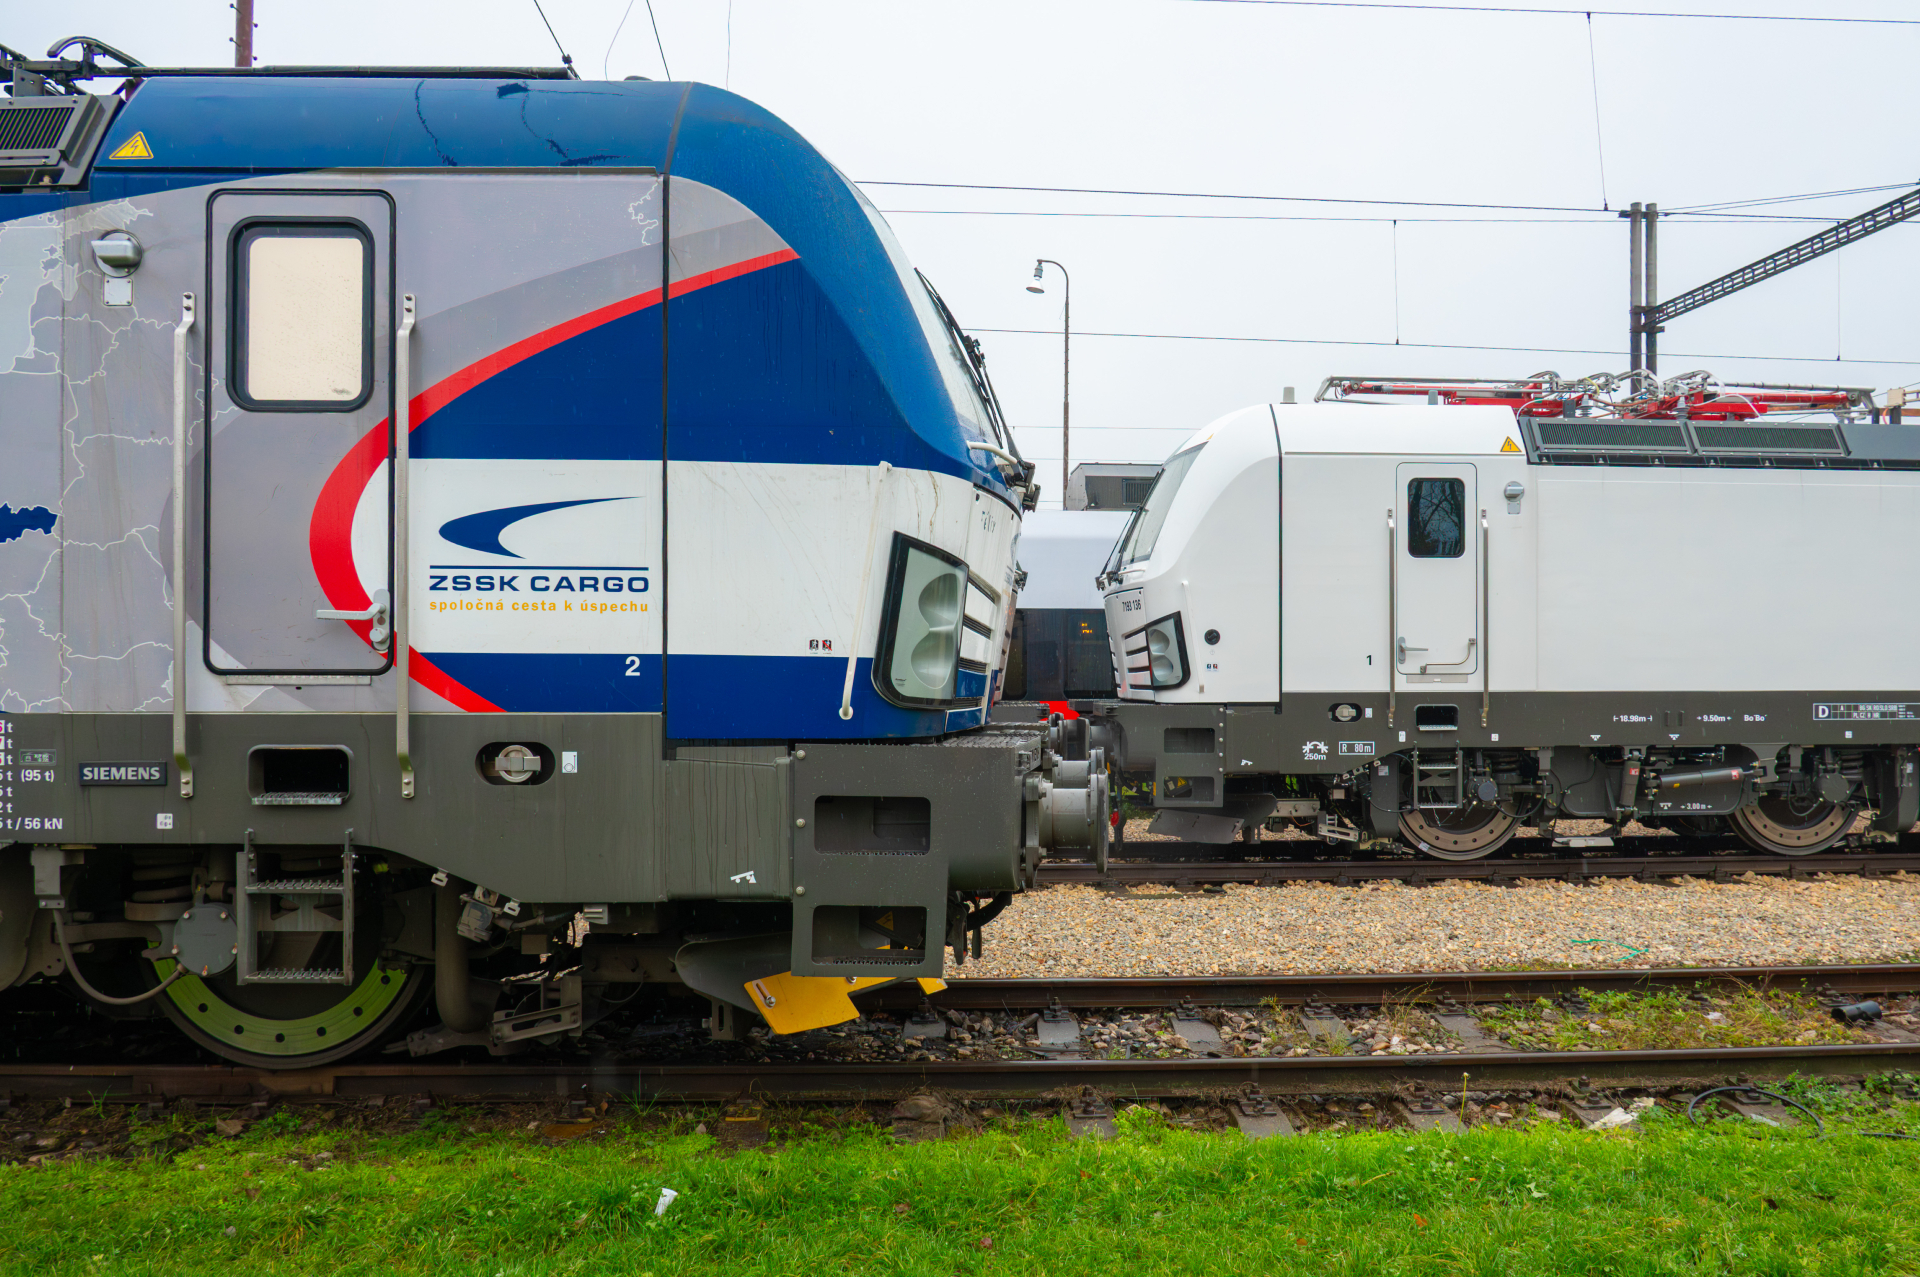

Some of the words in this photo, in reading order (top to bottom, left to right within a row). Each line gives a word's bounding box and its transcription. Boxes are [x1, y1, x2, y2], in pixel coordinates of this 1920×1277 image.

[429, 575, 519, 592] ZSSK
[530, 575, 650, 593] CARGO
[429, 598, 504, 613] spoločná
[511, 600, 557, 612] cesta
[564, 600, 573, 612] k
[580, 599, 649, 614] úspechu
[1121, 601, 1133, 612] 7193
[1132, 599, 1142, 611] 136
[1366, 654, 1372, 666] 1
[625, 656, 641, 677] 2
[1818, 705, 1829, 718] D
[1619, 714, 1647, 723] 18.98m
[1702, 714, 1726, 722] 9.50m
[6, 722, 13, 733] t
[6, 738, 13, 749] t
[1341, 743, 1348, 753] R
[6, 754, 13, 765] t
[1304, 752, 1327, 761] 250m
[6, 770, 13, 781] t
[20, 769, 42, 783] (95
[44, 769, 55, 783] t)
[82, 766, 161, 780] SIEMENS
[6, 786, 13, 797] t
[6, 802, 13, 813] t
[6, 818, 13, 829] t
[24, 817, 42, 830] 56
[44, 818, 63, 830] kN
